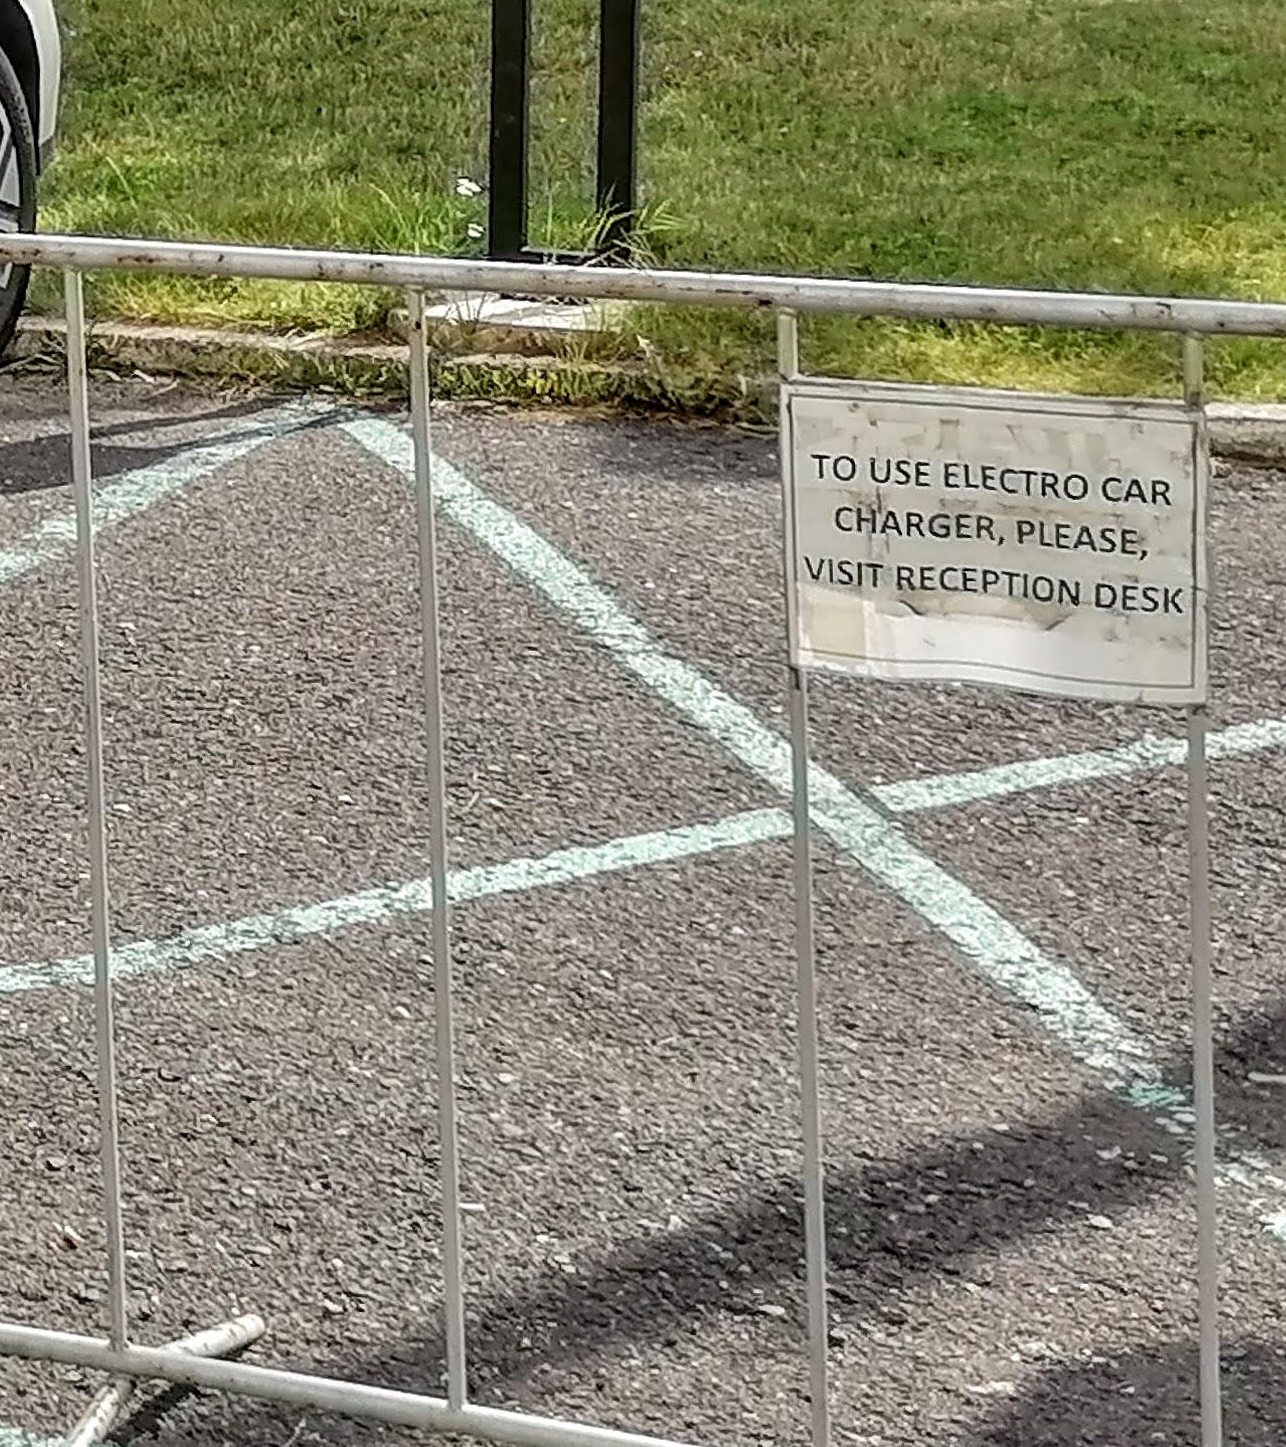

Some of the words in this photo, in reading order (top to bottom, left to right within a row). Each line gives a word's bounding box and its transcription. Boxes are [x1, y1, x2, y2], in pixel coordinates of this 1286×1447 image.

[810, 453, 857, 482] TO
[869, 457, 931, 488] USE
[943, 462, 1089, 501] ELECTRO
[1101, 477, 1172, 506] CAR
[834, 506, 1005, 546] CHARGER,
[1015, 519, 1148, 561] PLEASE,
[803, 555, 884, 589] VISIT
[895, 565, 1081, 607] RECEPTION
[1093, 582, 1183, 614] DESK
